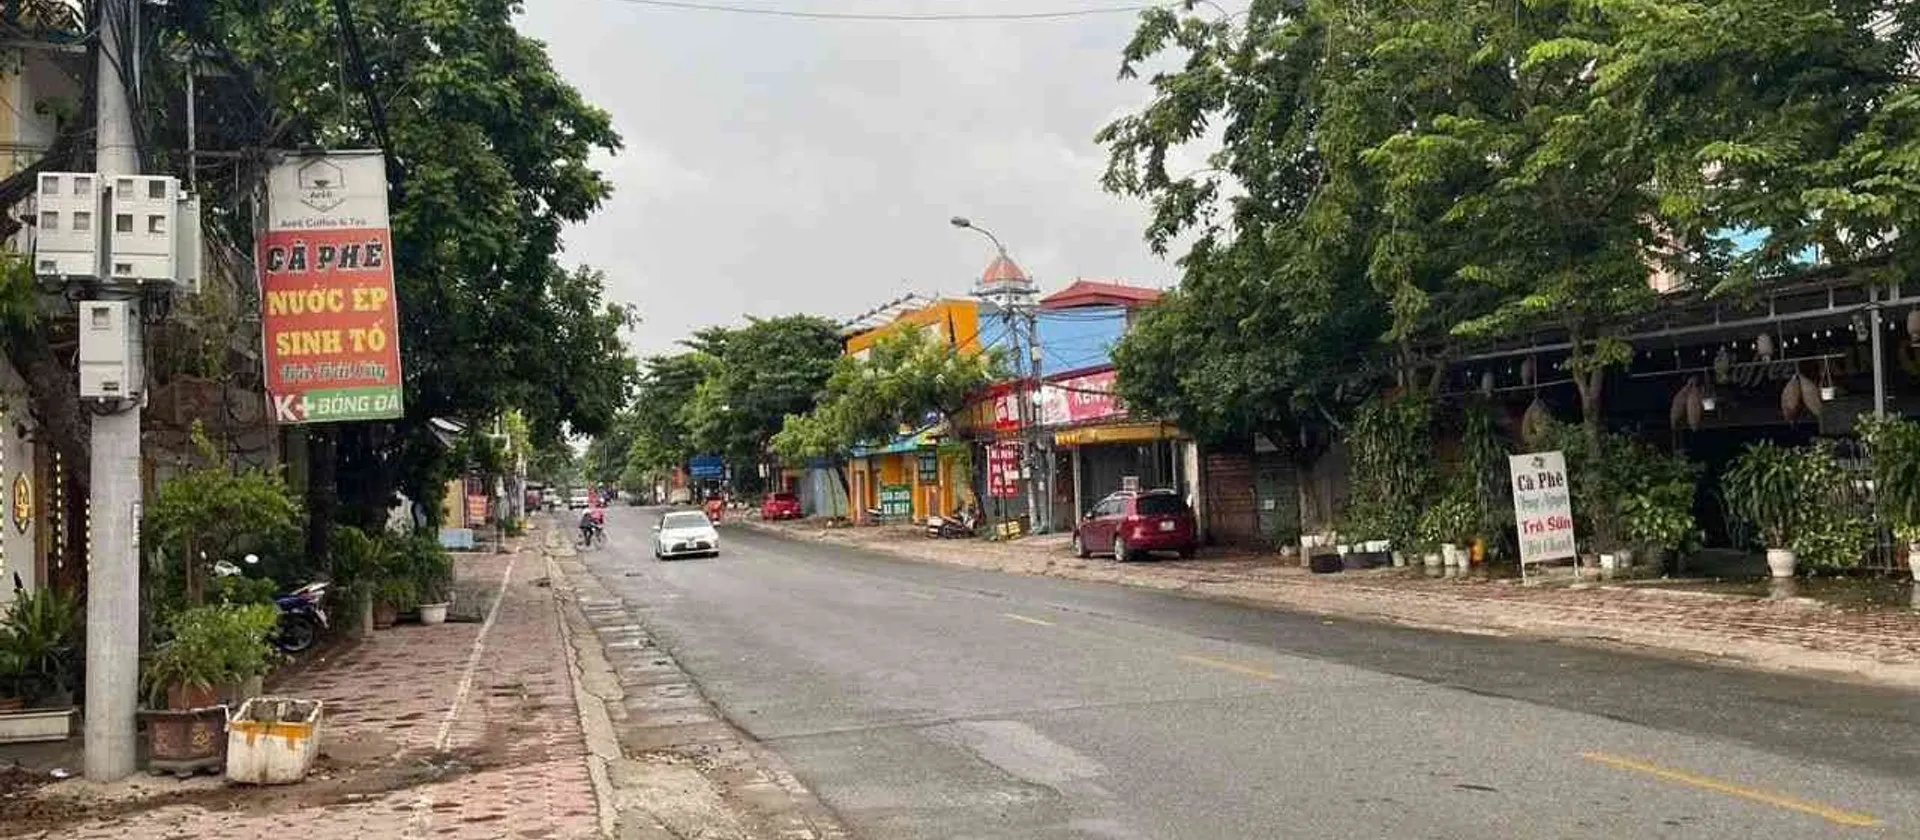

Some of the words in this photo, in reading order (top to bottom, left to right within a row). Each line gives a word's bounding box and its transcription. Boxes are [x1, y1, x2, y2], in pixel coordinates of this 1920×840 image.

[265, 240, 306, 271] CÀ
[316, 237, 383, 270] PHÊ
[265, 283, 345, 316] NƯỚC
[351, 282, 388, 312] ÉP
[275, 329, 343, 356] SINH
[348, 319, 386, 353] TỐ
[273, 394, 315, 421] K+
[317, 393, 369, 415] BÓNG
[1517, 473, 1535, 491] Cà
[1538, 470, 1563, 489] Phê
[1521, 518, 1545, 534] Trà
